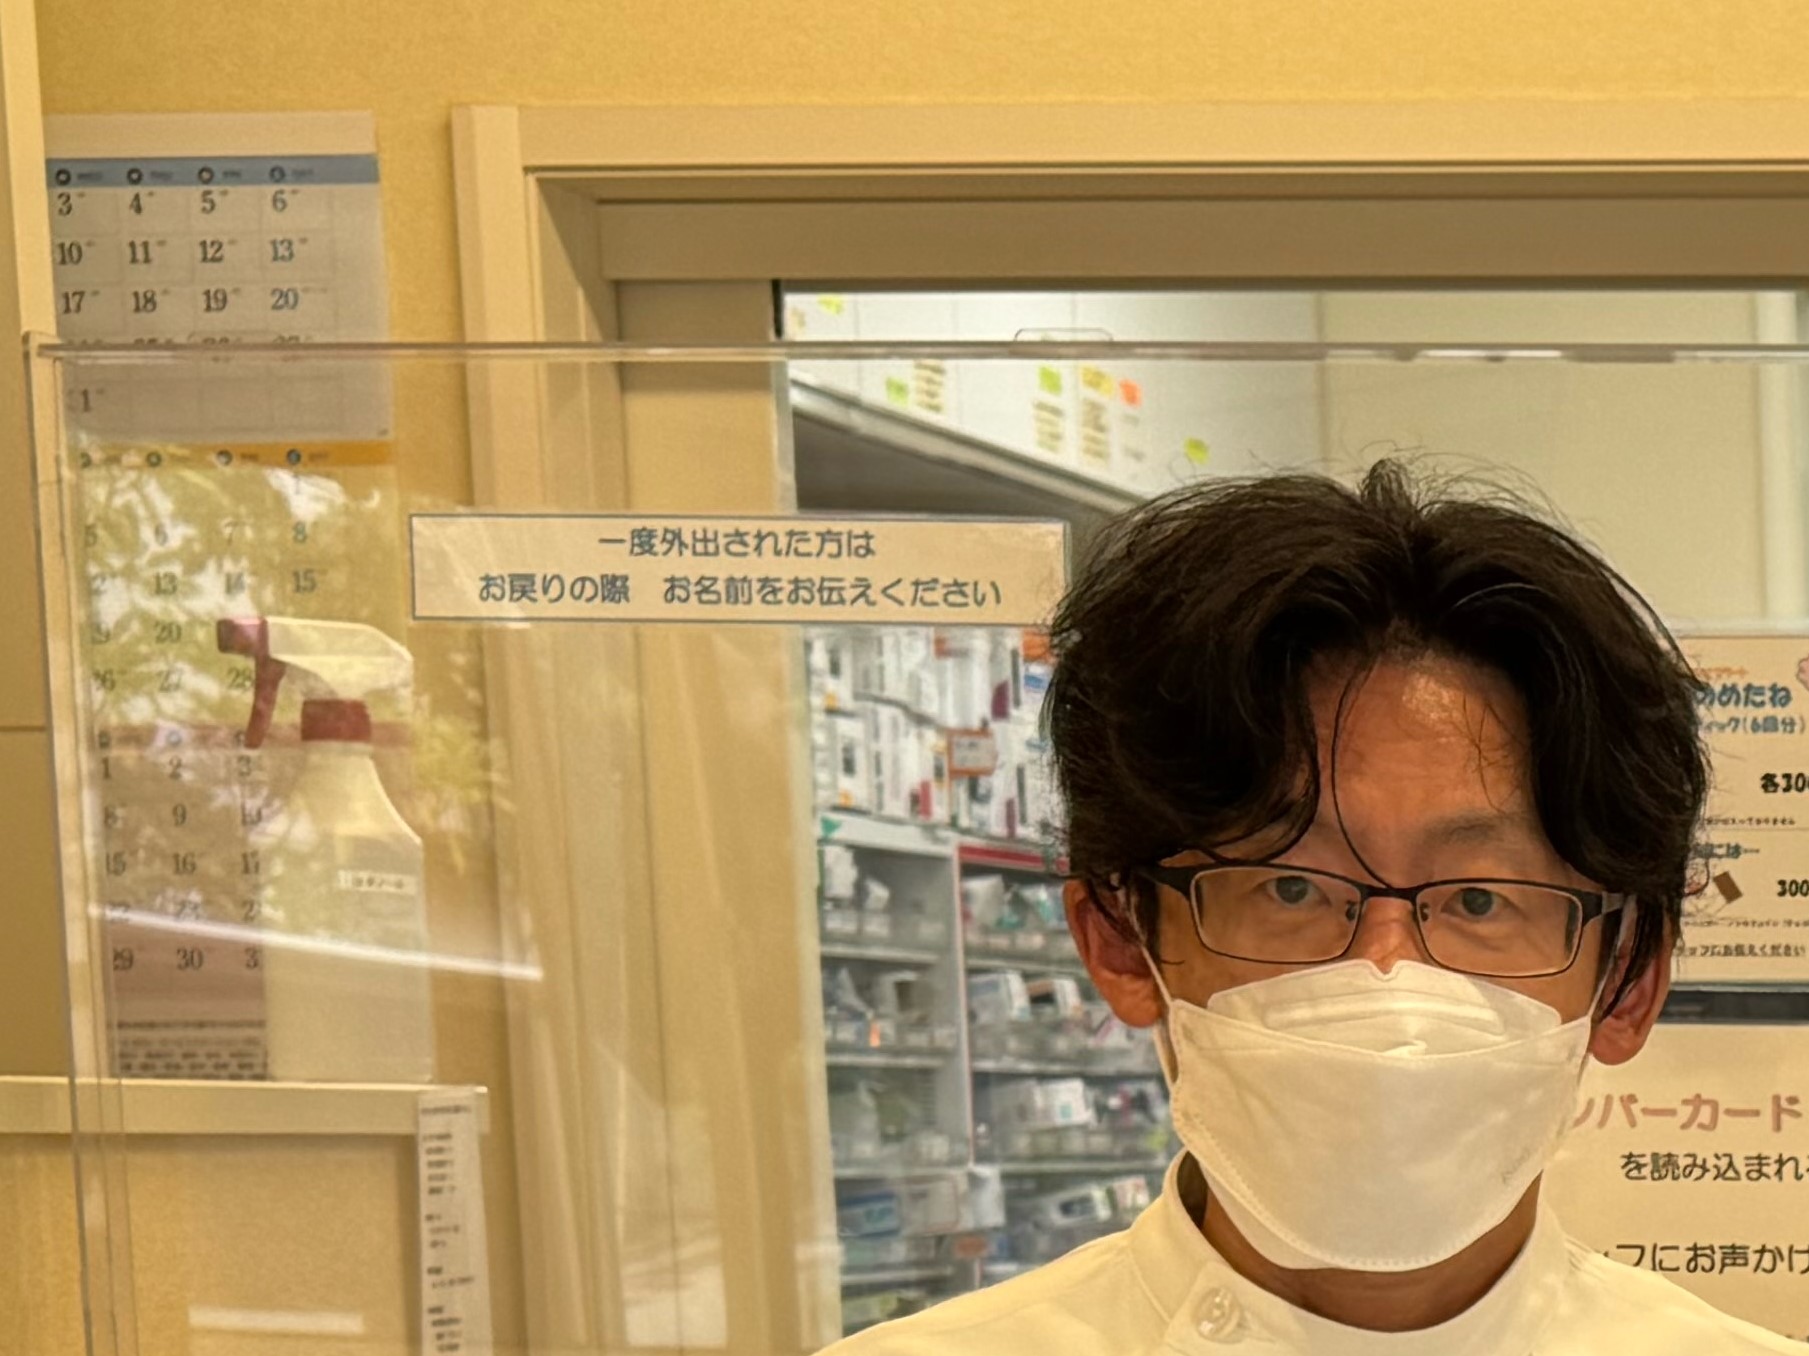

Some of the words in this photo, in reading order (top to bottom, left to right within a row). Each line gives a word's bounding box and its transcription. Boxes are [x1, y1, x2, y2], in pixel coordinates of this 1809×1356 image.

[58, 192, 73, 216] 3
[129, 192, 143, 215] 4
[201, 190, 216, 214] 5
[272, 189, 288, 213] 6
[57, 241, 83, 265] 10
[128, 240, 152, 265] 11
[200, 239, 224, 263] 12
[270, 238, 295, 262] 13
[61, 290, 86, 314] 17
[132, 290, 157, 314] 18
[203, 288, 228, 312] 19
[270, 287, 299, 311] 20
[292, 520, 308, 544] 8
[598, 526, 876, 559] 一度外出された方は
[154, 572, 178, 597] 13
[292, 568, 318, 594] 15
[478, 572, 631, 604] お戻りの際
[662, 574, 1003, 609] お名前をお伝えください
[154, 620, 182, 644] 20
[169, 756, 182, 781] 2
[172, 803, 188, 828] 9
[172, 852, 197, 876] 16
[176, 947, 205, 972] 30
